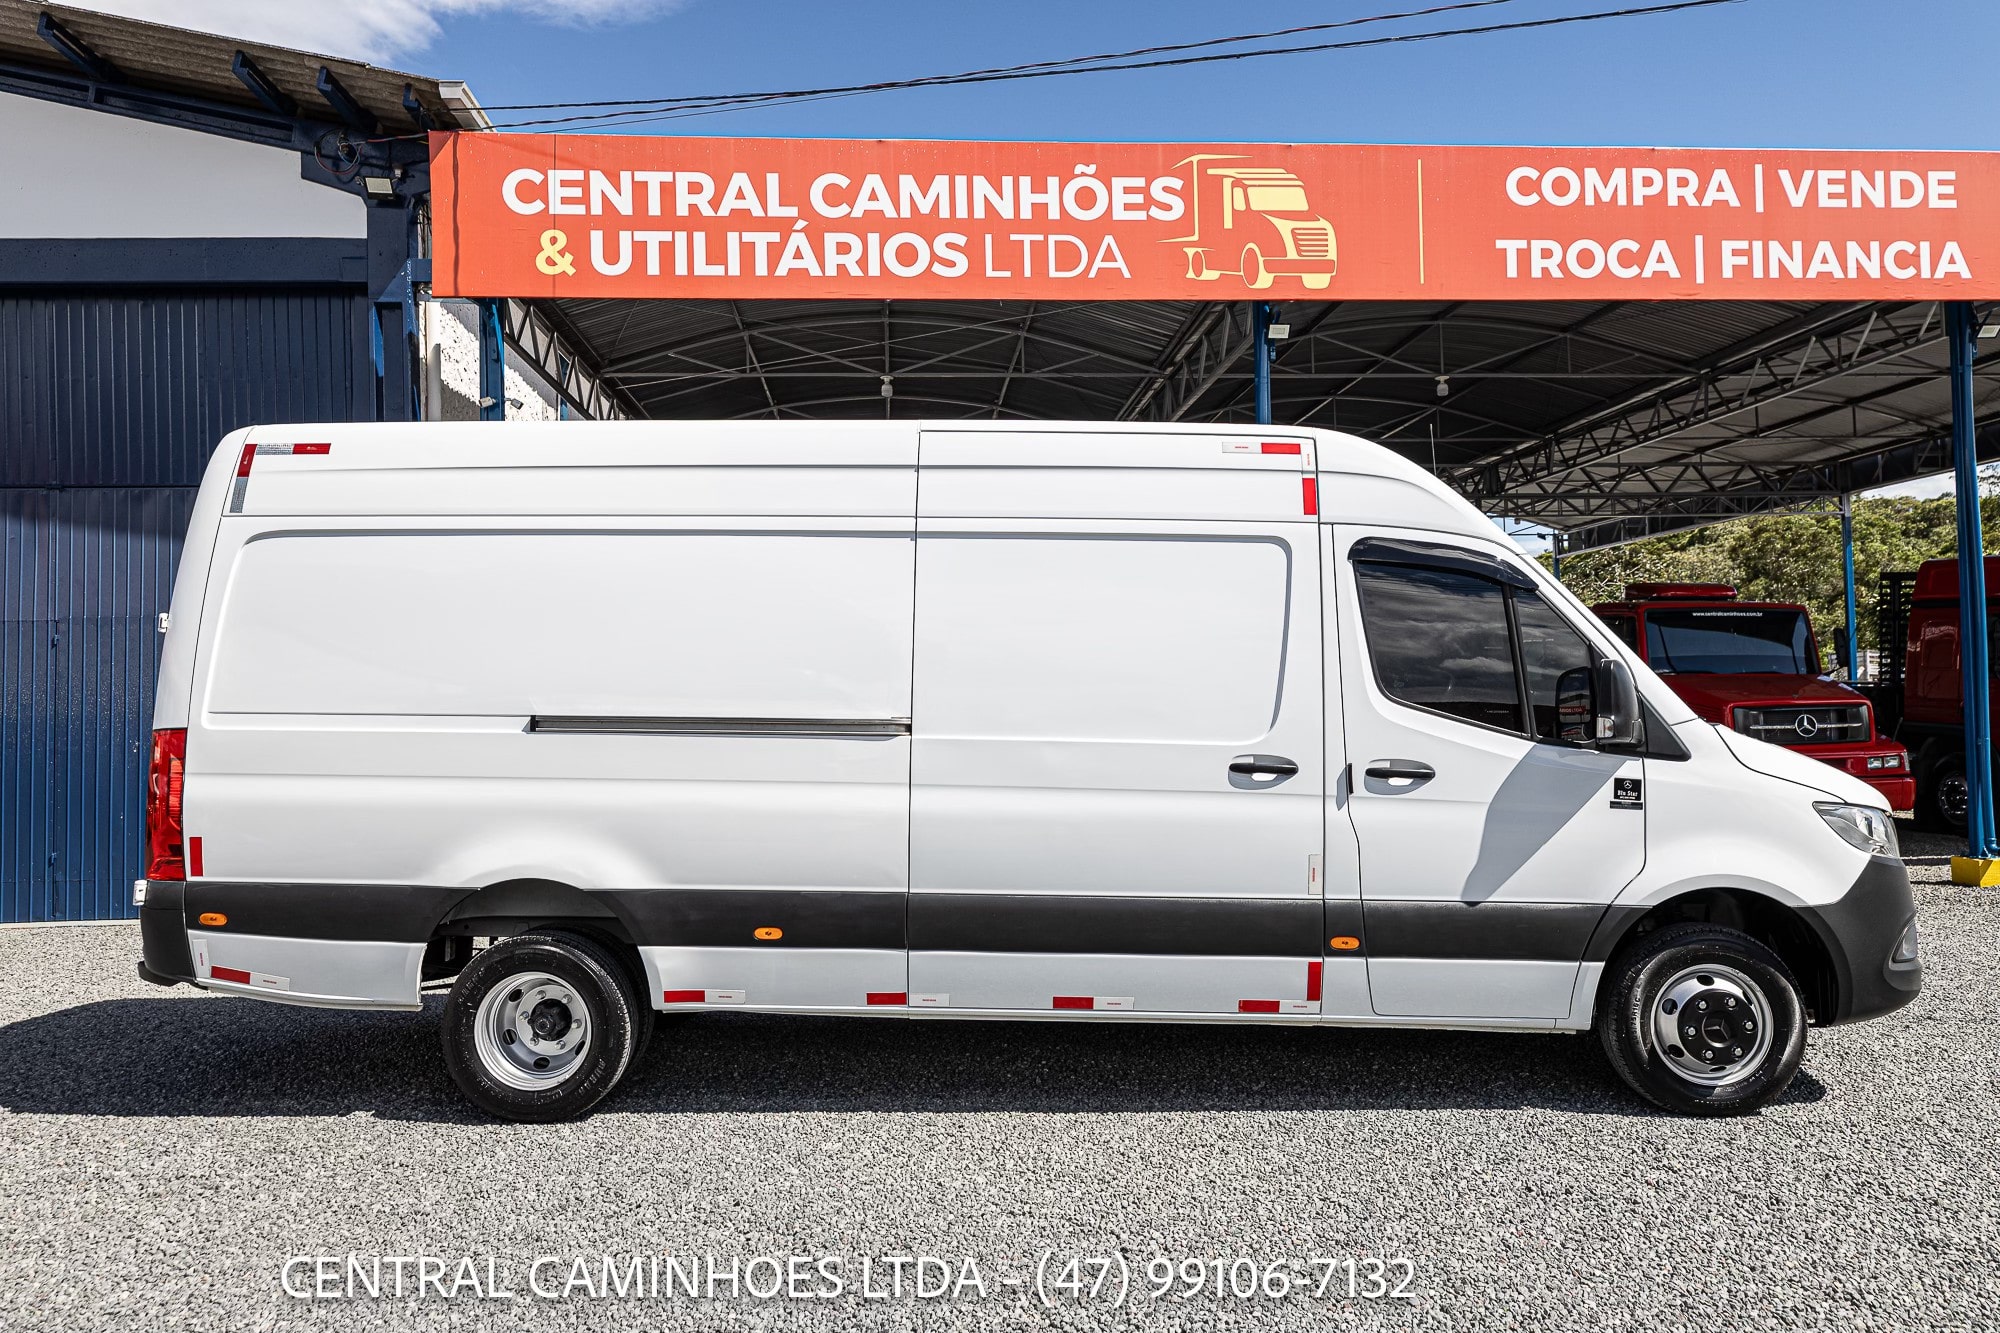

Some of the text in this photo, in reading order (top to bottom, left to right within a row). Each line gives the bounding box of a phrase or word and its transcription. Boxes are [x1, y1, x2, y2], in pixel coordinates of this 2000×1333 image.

[501, 163, 1185, 222] CENTRAL CAMINHÕES
[1505, 166, 1741, 208] COMPRA
[1777, 169, 1958, 209] VENDE
[535, 218, 1132, 279] & UTILITÁRIOS LTDA
[1495, 239, 1681, 279] TROCA
[1721, 240, 1973, 280] FINANCIA
